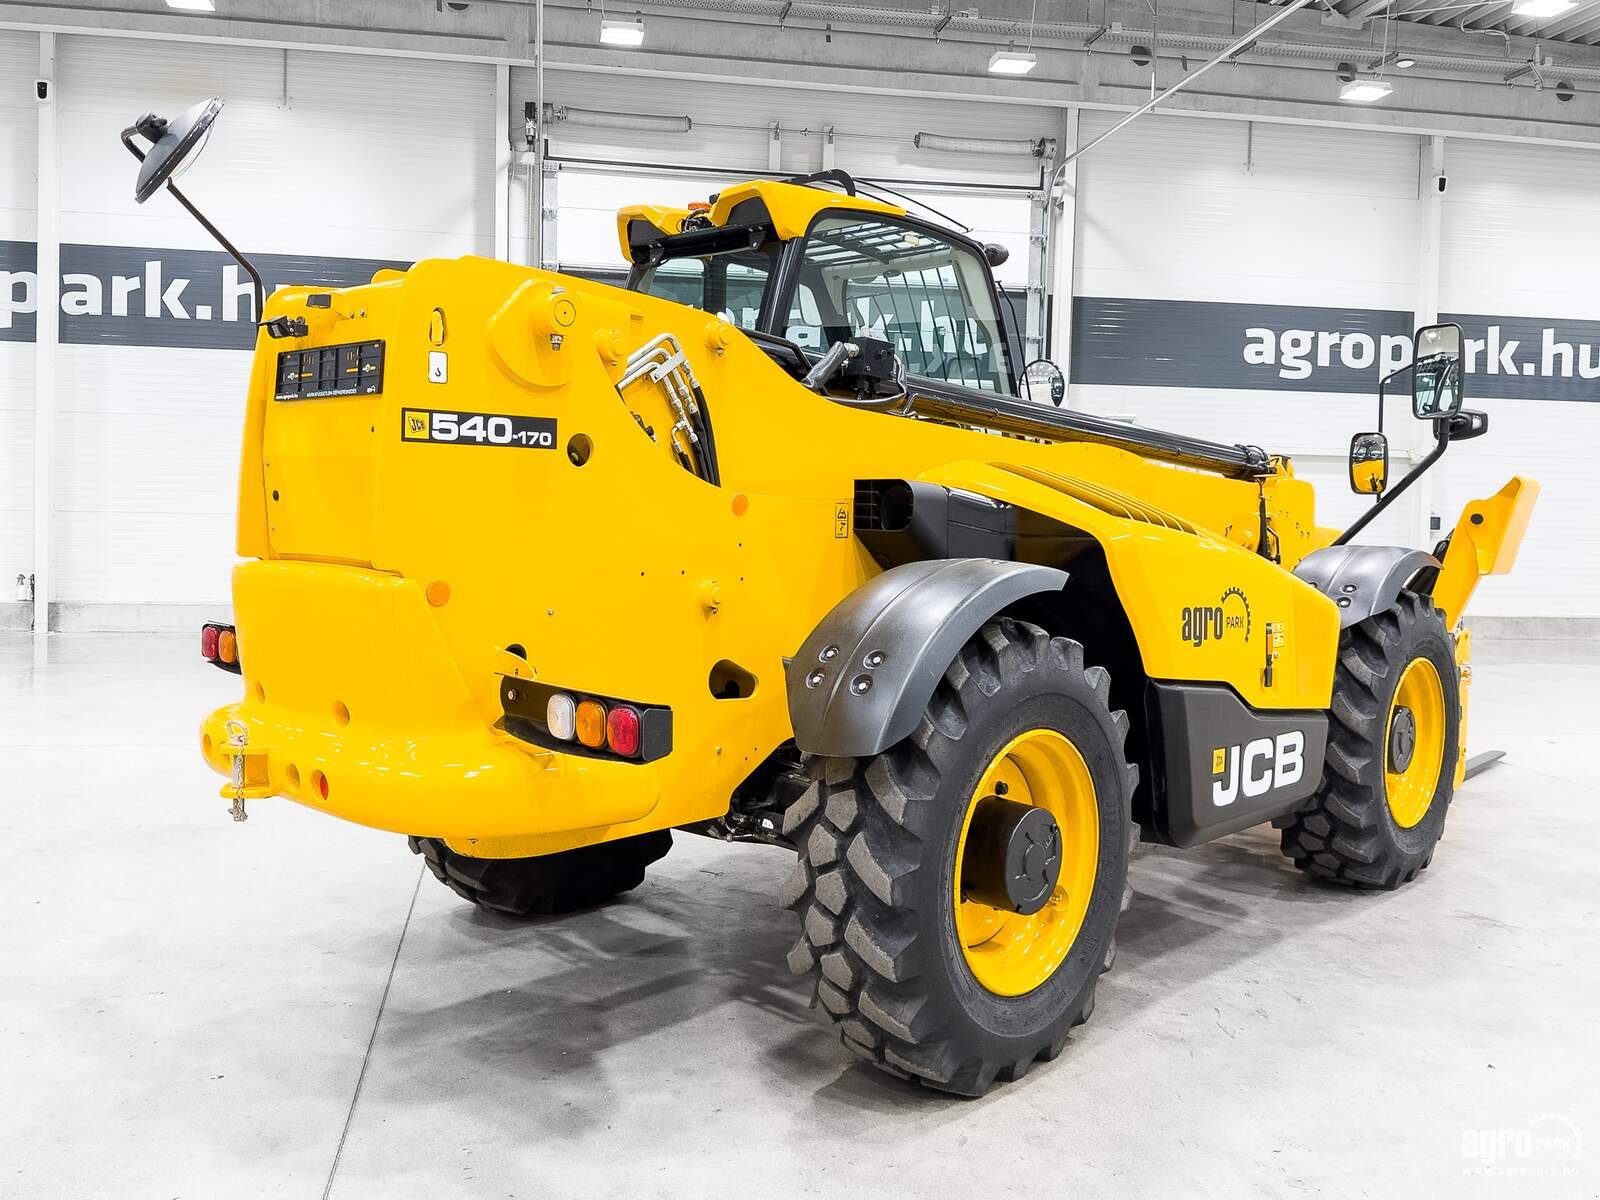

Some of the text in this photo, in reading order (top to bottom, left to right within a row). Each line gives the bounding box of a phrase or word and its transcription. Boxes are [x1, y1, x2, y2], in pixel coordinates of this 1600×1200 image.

[1243, 325, 1600, 384] agroprk.hu
[431, 412, 552, 446] 540-170
[1181, 606, 1245, 648] agro PARK
[1212, 730, 1305, 807] JCB
